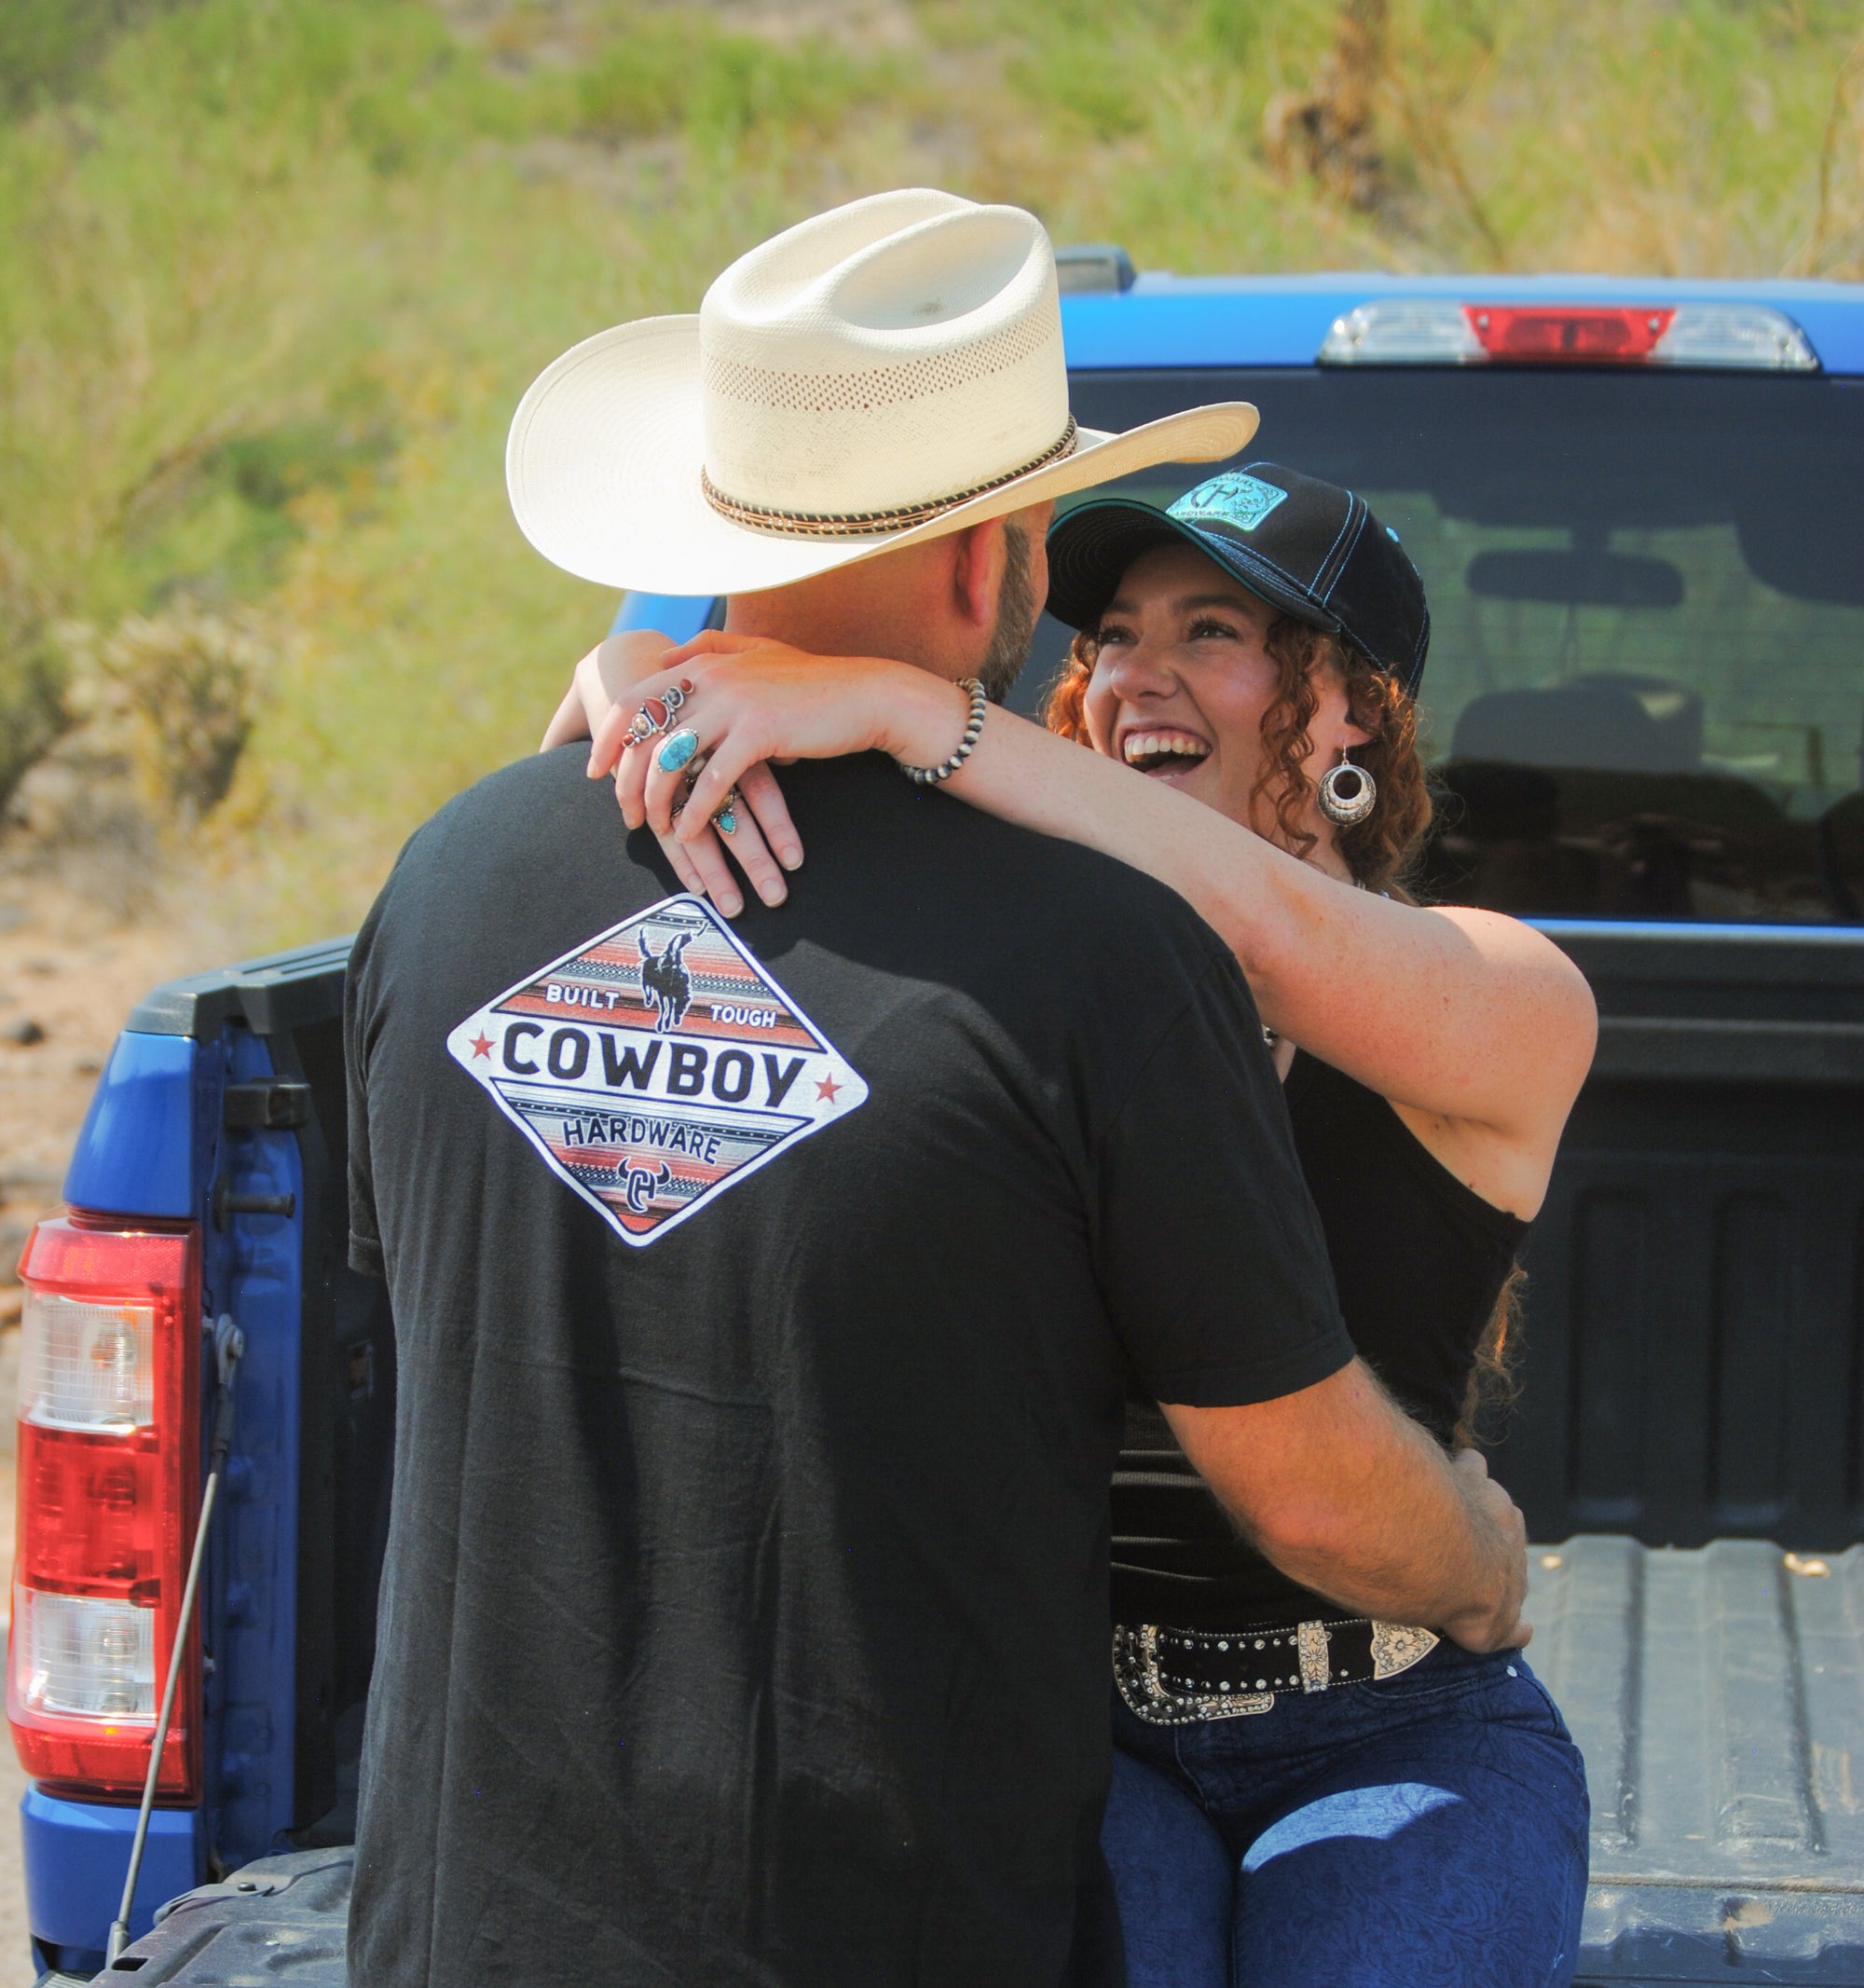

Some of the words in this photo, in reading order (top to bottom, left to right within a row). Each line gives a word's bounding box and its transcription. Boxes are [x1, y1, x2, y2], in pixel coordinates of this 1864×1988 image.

[545, 983, 620, 1011] BUILT
[709, 1003, 776, 1029] TOUGH
[501, 1021, 806, 1108] COWBOY
[563, 1117, 722, 1165] HARDWARE
